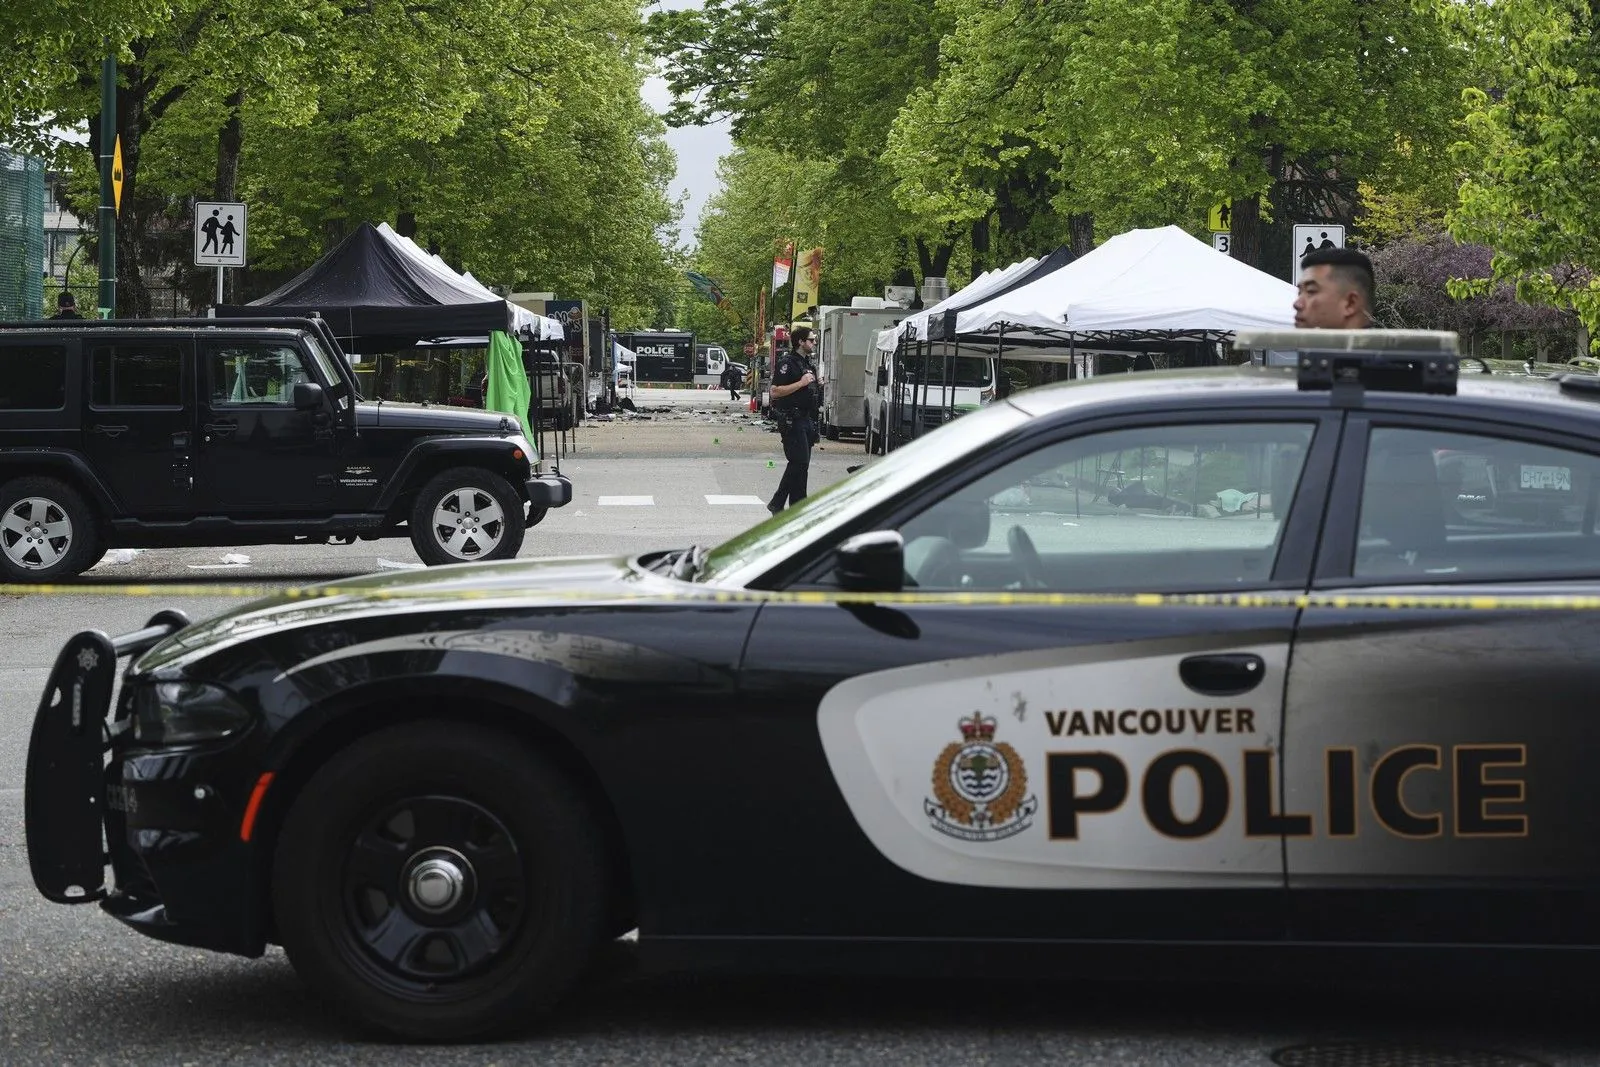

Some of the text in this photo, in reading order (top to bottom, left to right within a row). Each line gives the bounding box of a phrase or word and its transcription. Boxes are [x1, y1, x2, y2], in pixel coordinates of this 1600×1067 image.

[1219, 236, 1229, 253] 3
[636, 346, 675, 355] POLICE
[1045, 708, 1256, 736] VANCOUVER
[1046, 742, 1529, 841] POLICE
